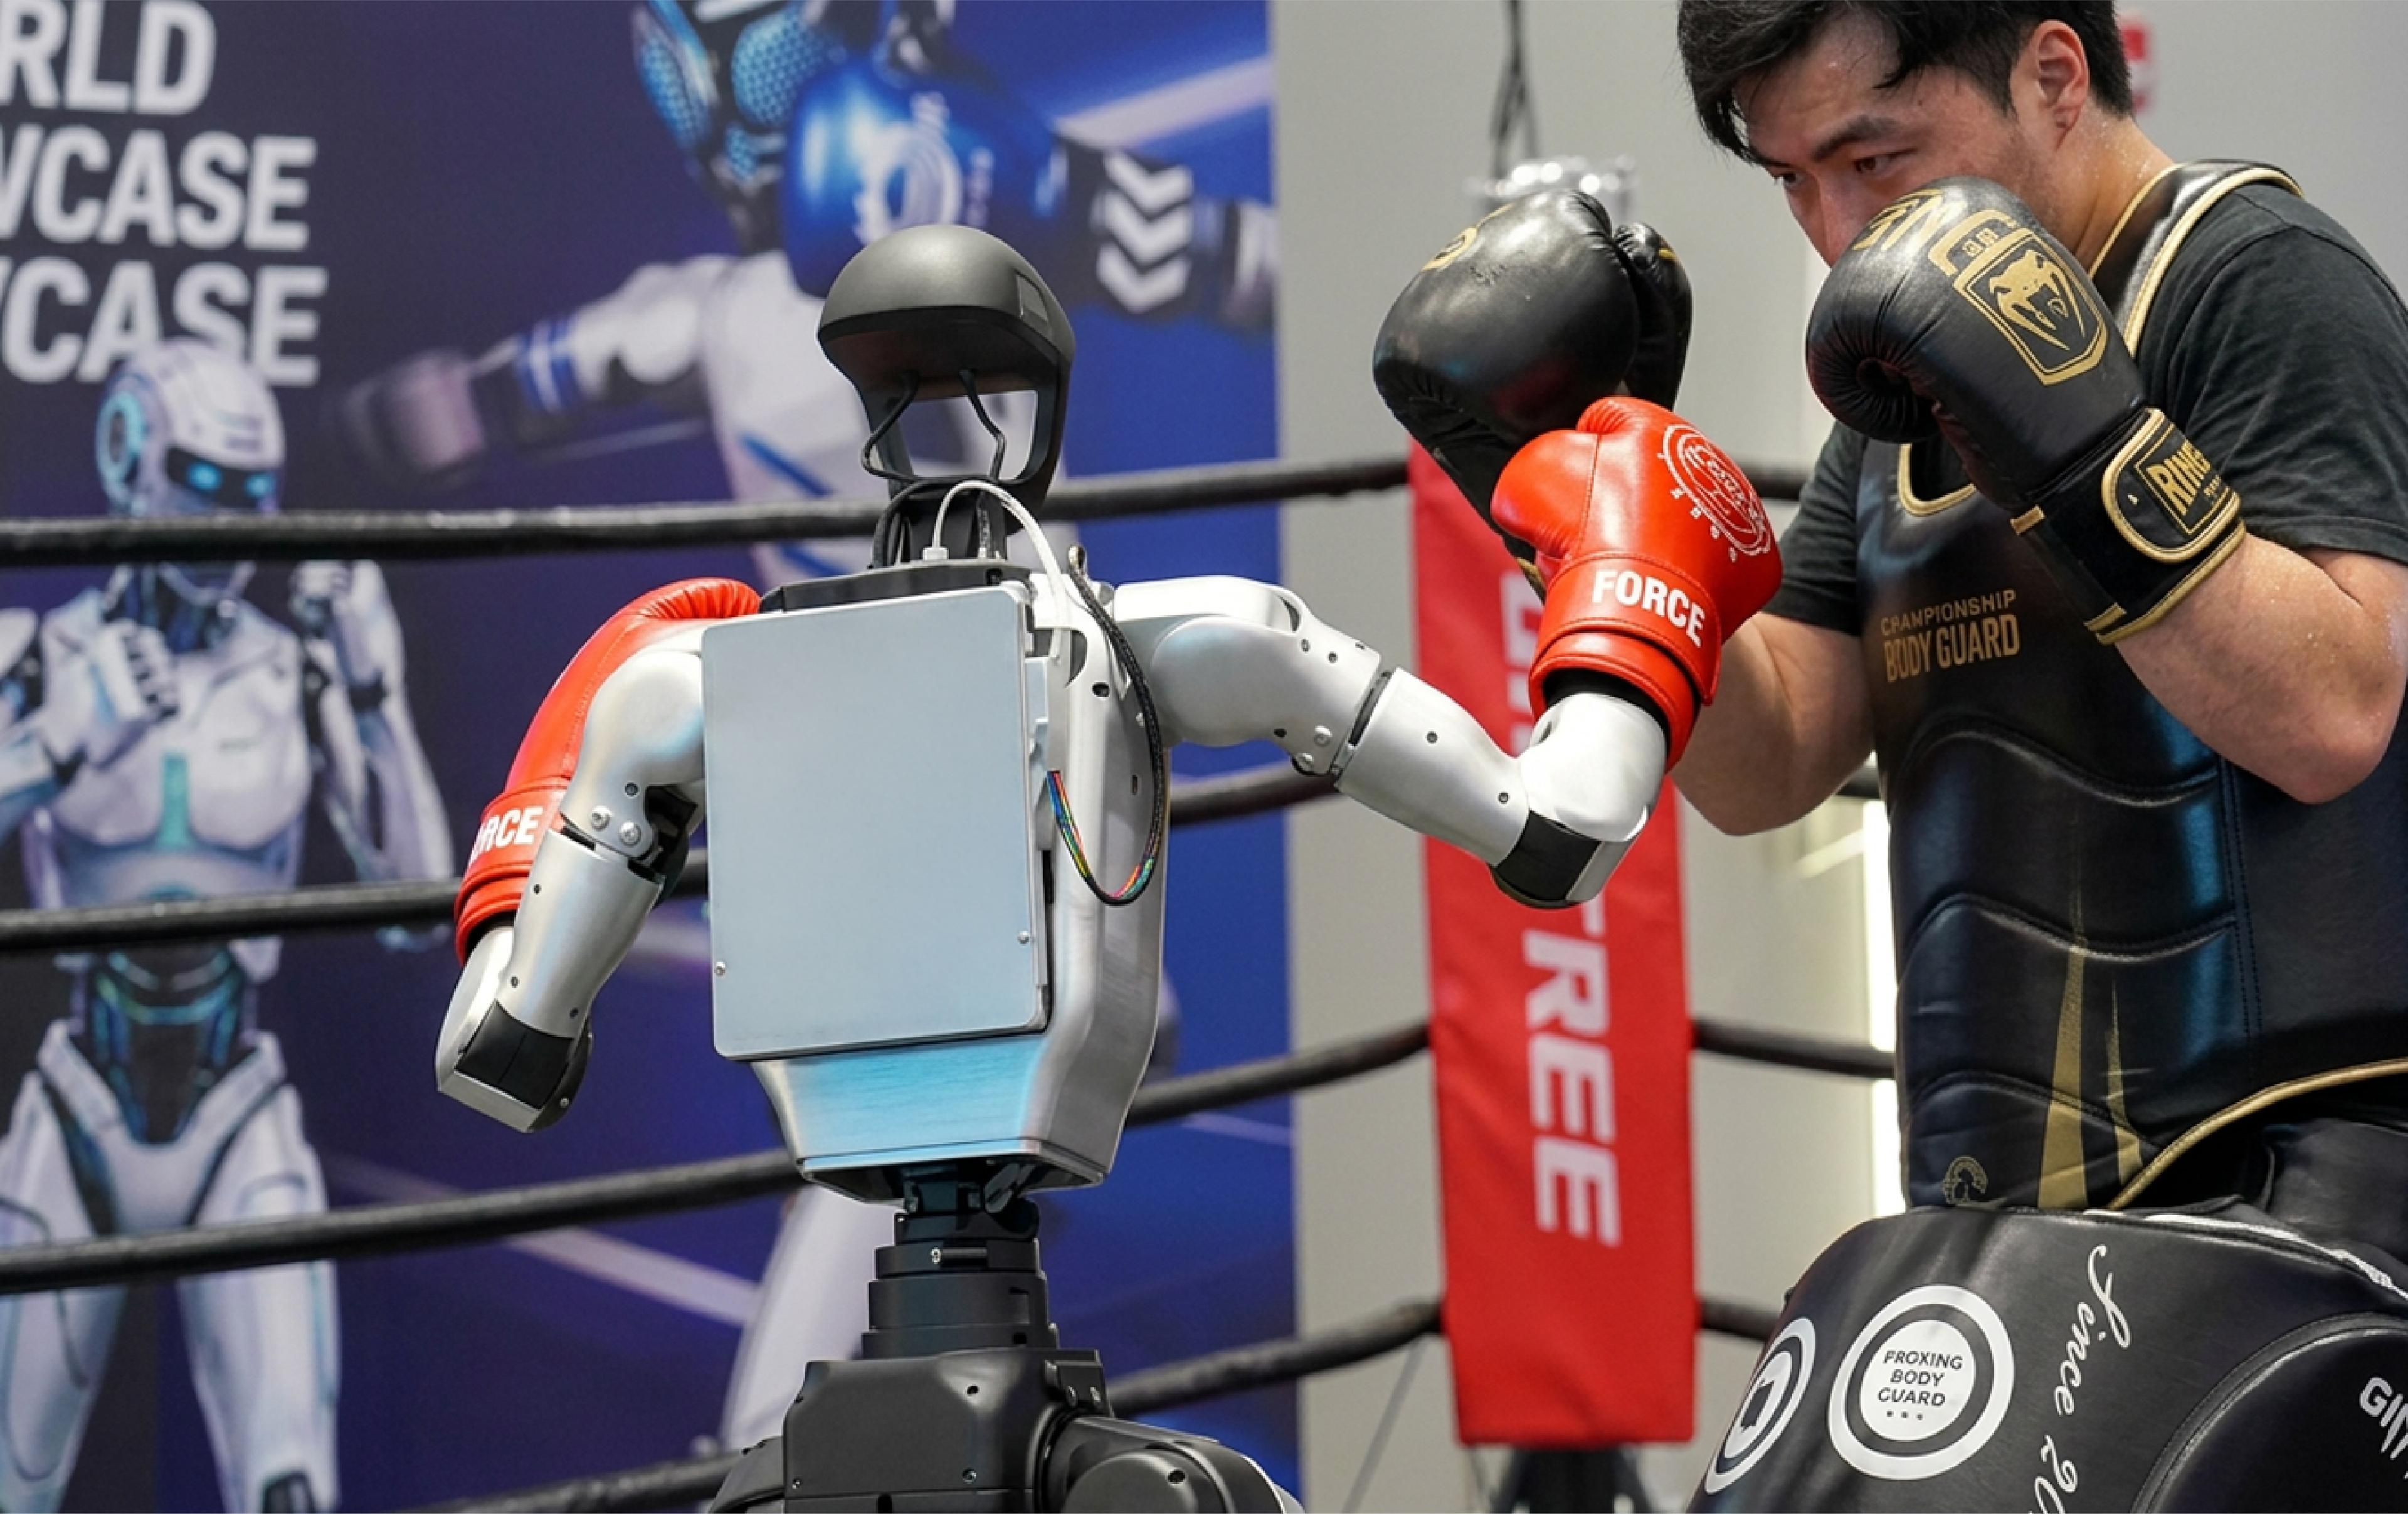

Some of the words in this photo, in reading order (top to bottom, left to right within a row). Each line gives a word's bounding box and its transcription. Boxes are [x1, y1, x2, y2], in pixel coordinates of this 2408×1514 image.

[0, 254, 330, 386] CASE
[1592, 570, 1706, 648] FORCE
[1884, 629, 1933, 683] BODY
[1936, 613, 2021, 669] GUARD
[2054, 1243, 2131, 1417] Since
[1877, 1387, 1946, 1407] GUARD
[1890, 1369, 1945, 1387] BODY
